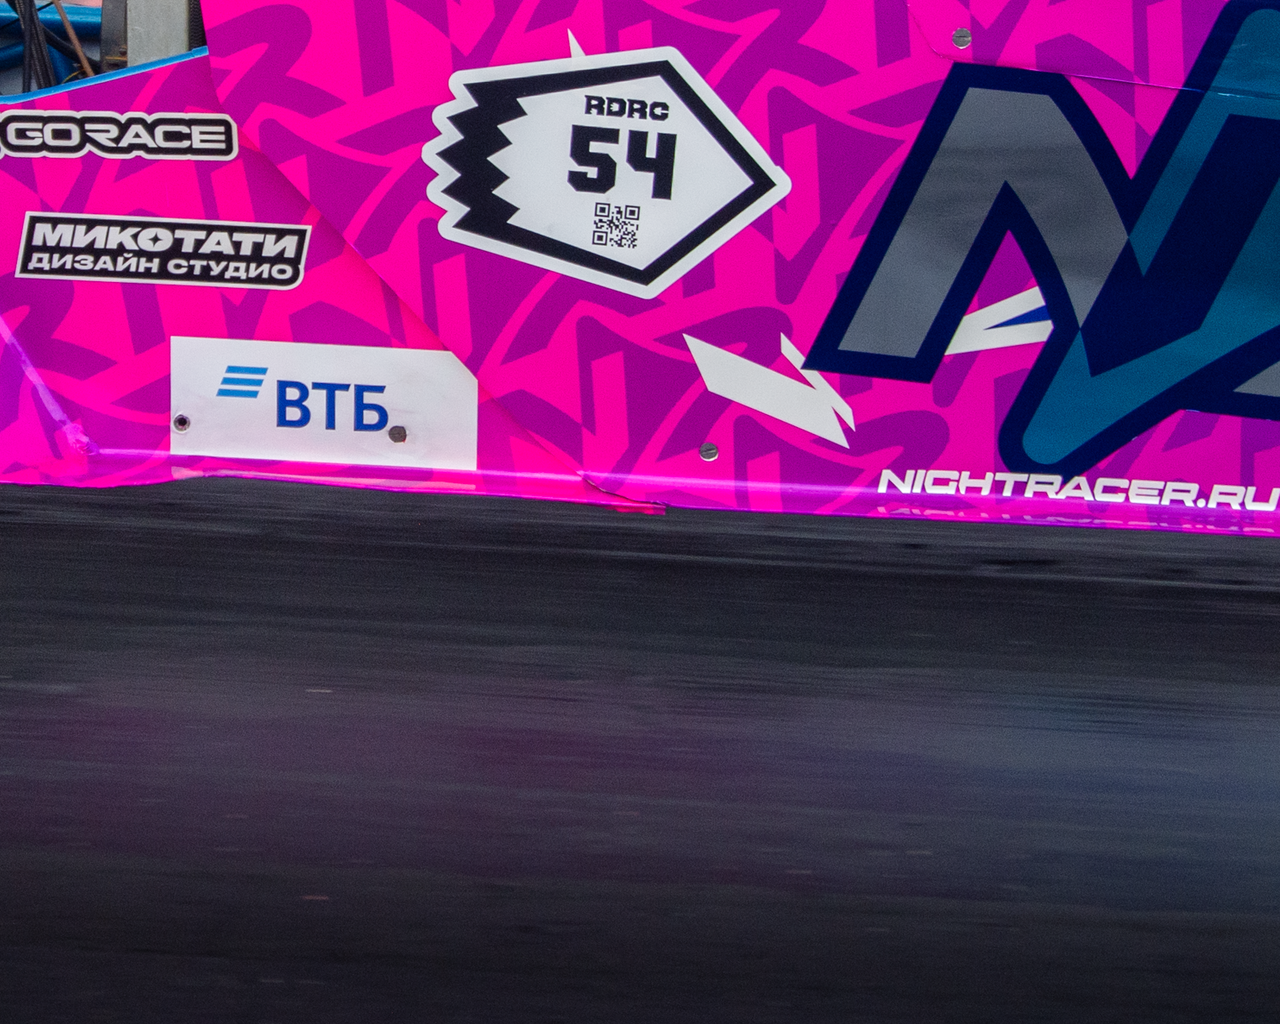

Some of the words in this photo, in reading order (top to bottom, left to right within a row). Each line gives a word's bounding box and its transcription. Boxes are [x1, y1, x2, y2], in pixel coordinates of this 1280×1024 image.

[584, 95, 669, 121] RDRC
[6, 122, 226, 149] GORACE
[567, 124, 677, 200] 54
[32, 223, 299, 258] МИКОТАТИ
[27, 252, 160, 274] ДИЗАЙН
[167, 259, 293, 280] СТУДИО
[276, 379, 389, 432] ВТБ
[877, 469, 1280, 512] NIGHTRACER.RU
